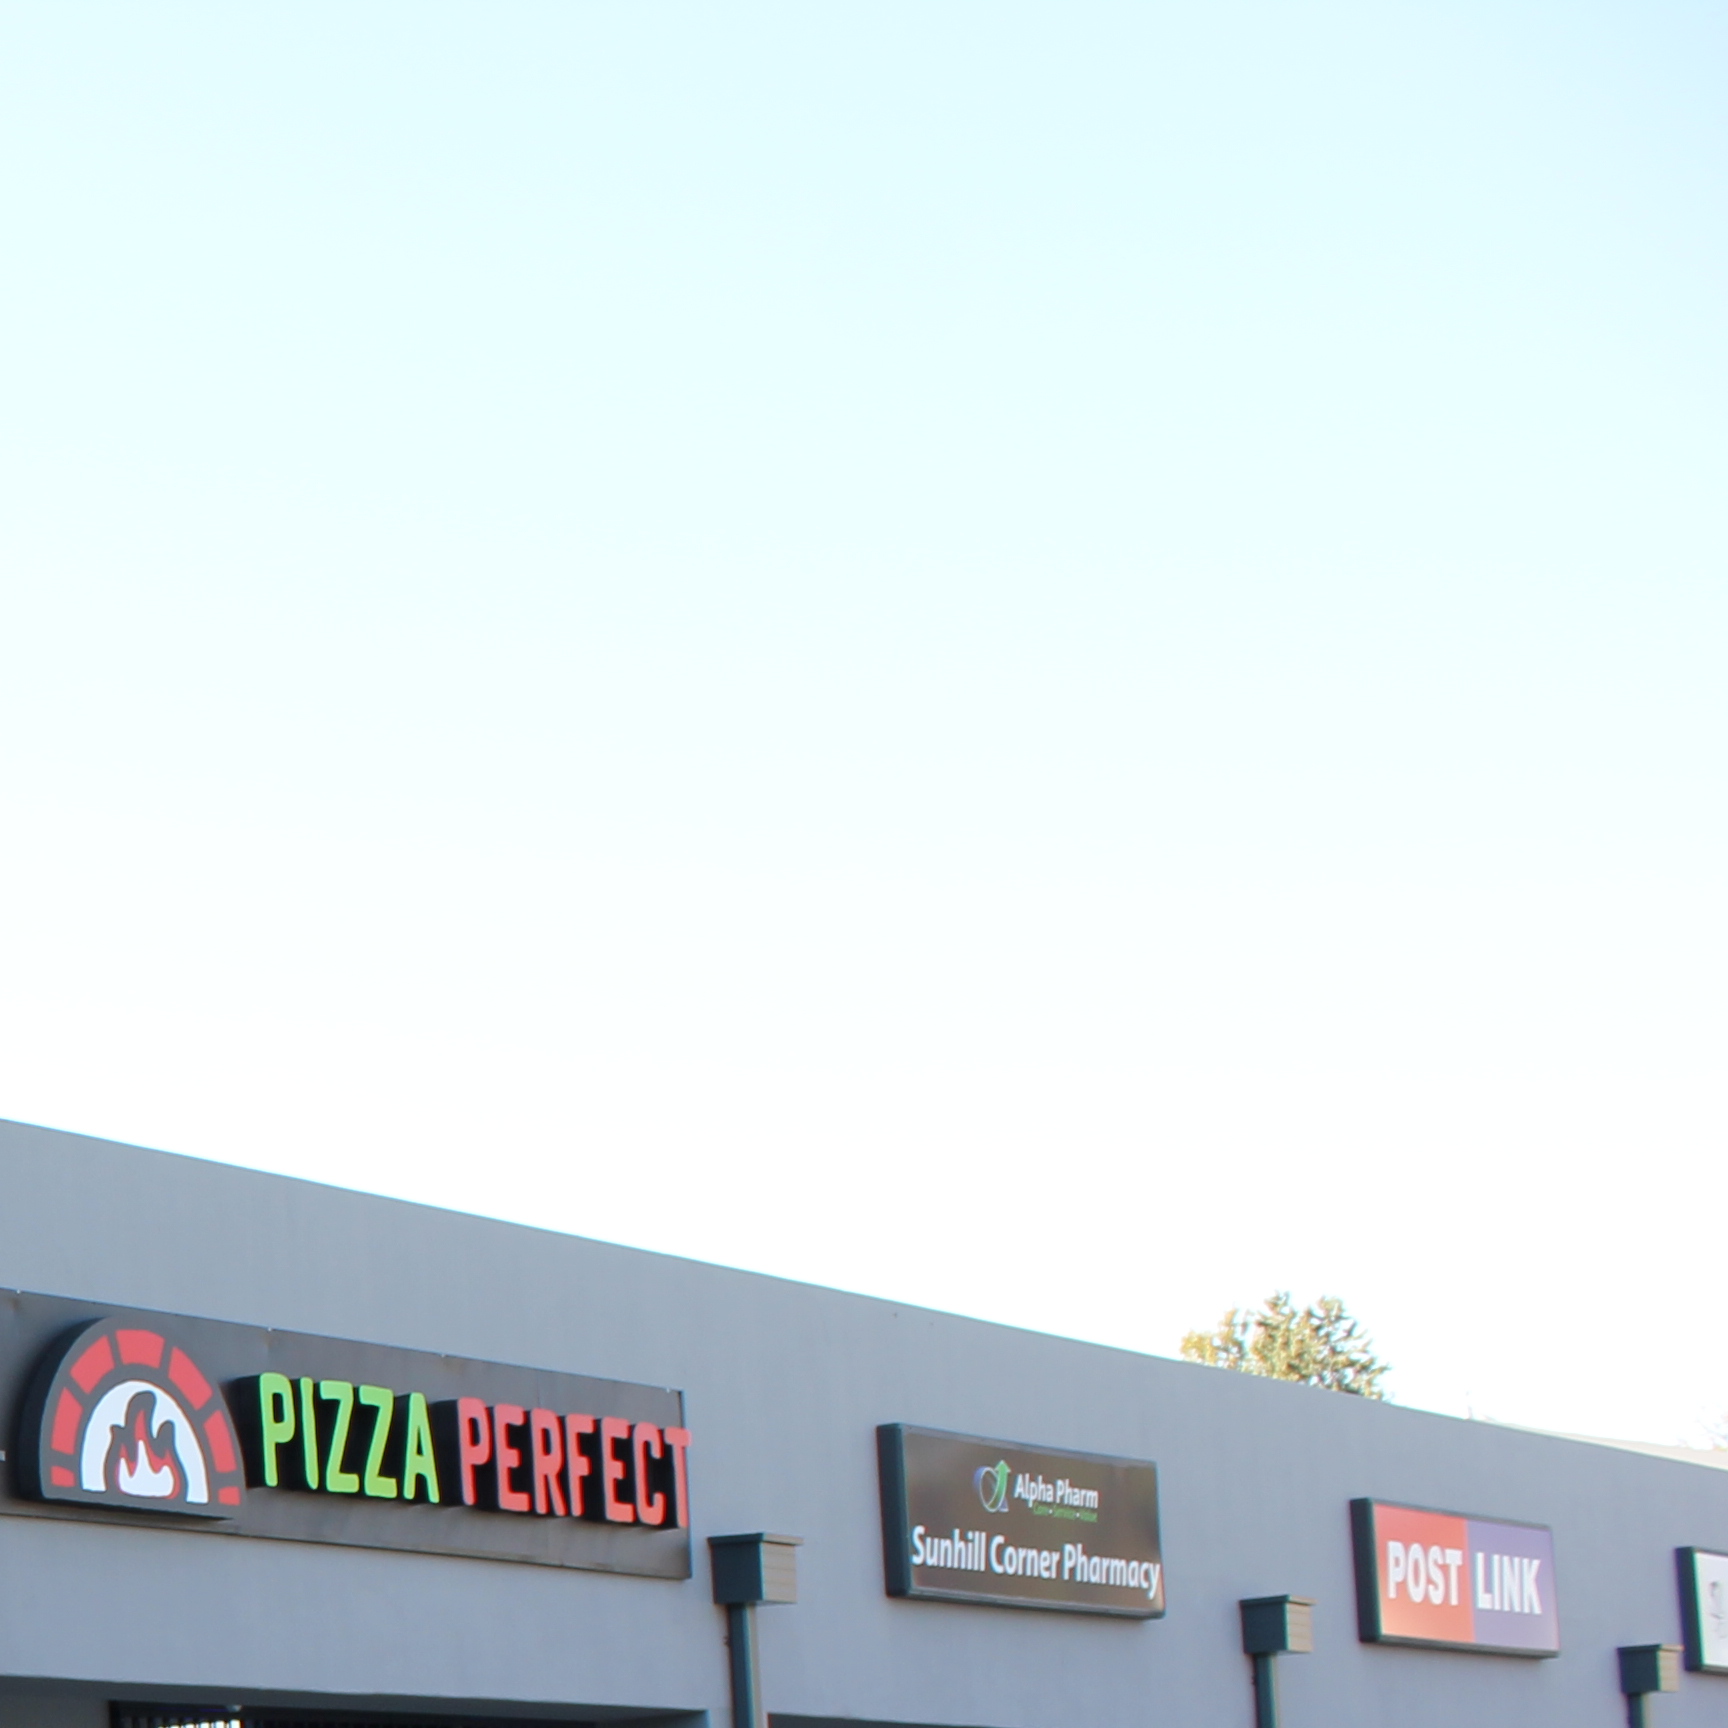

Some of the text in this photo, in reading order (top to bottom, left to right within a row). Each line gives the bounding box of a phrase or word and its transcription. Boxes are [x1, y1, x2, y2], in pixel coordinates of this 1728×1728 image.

[256, 1371, 692, 1529] PIZZA PERFECT
[1014, 1474, 1099, 1509] Alpha Pharm
[911, 1524, 1162, 1600] Sunhill Corner Pharmacy
[1386, 1539, 1543, 1616] POST LINK
